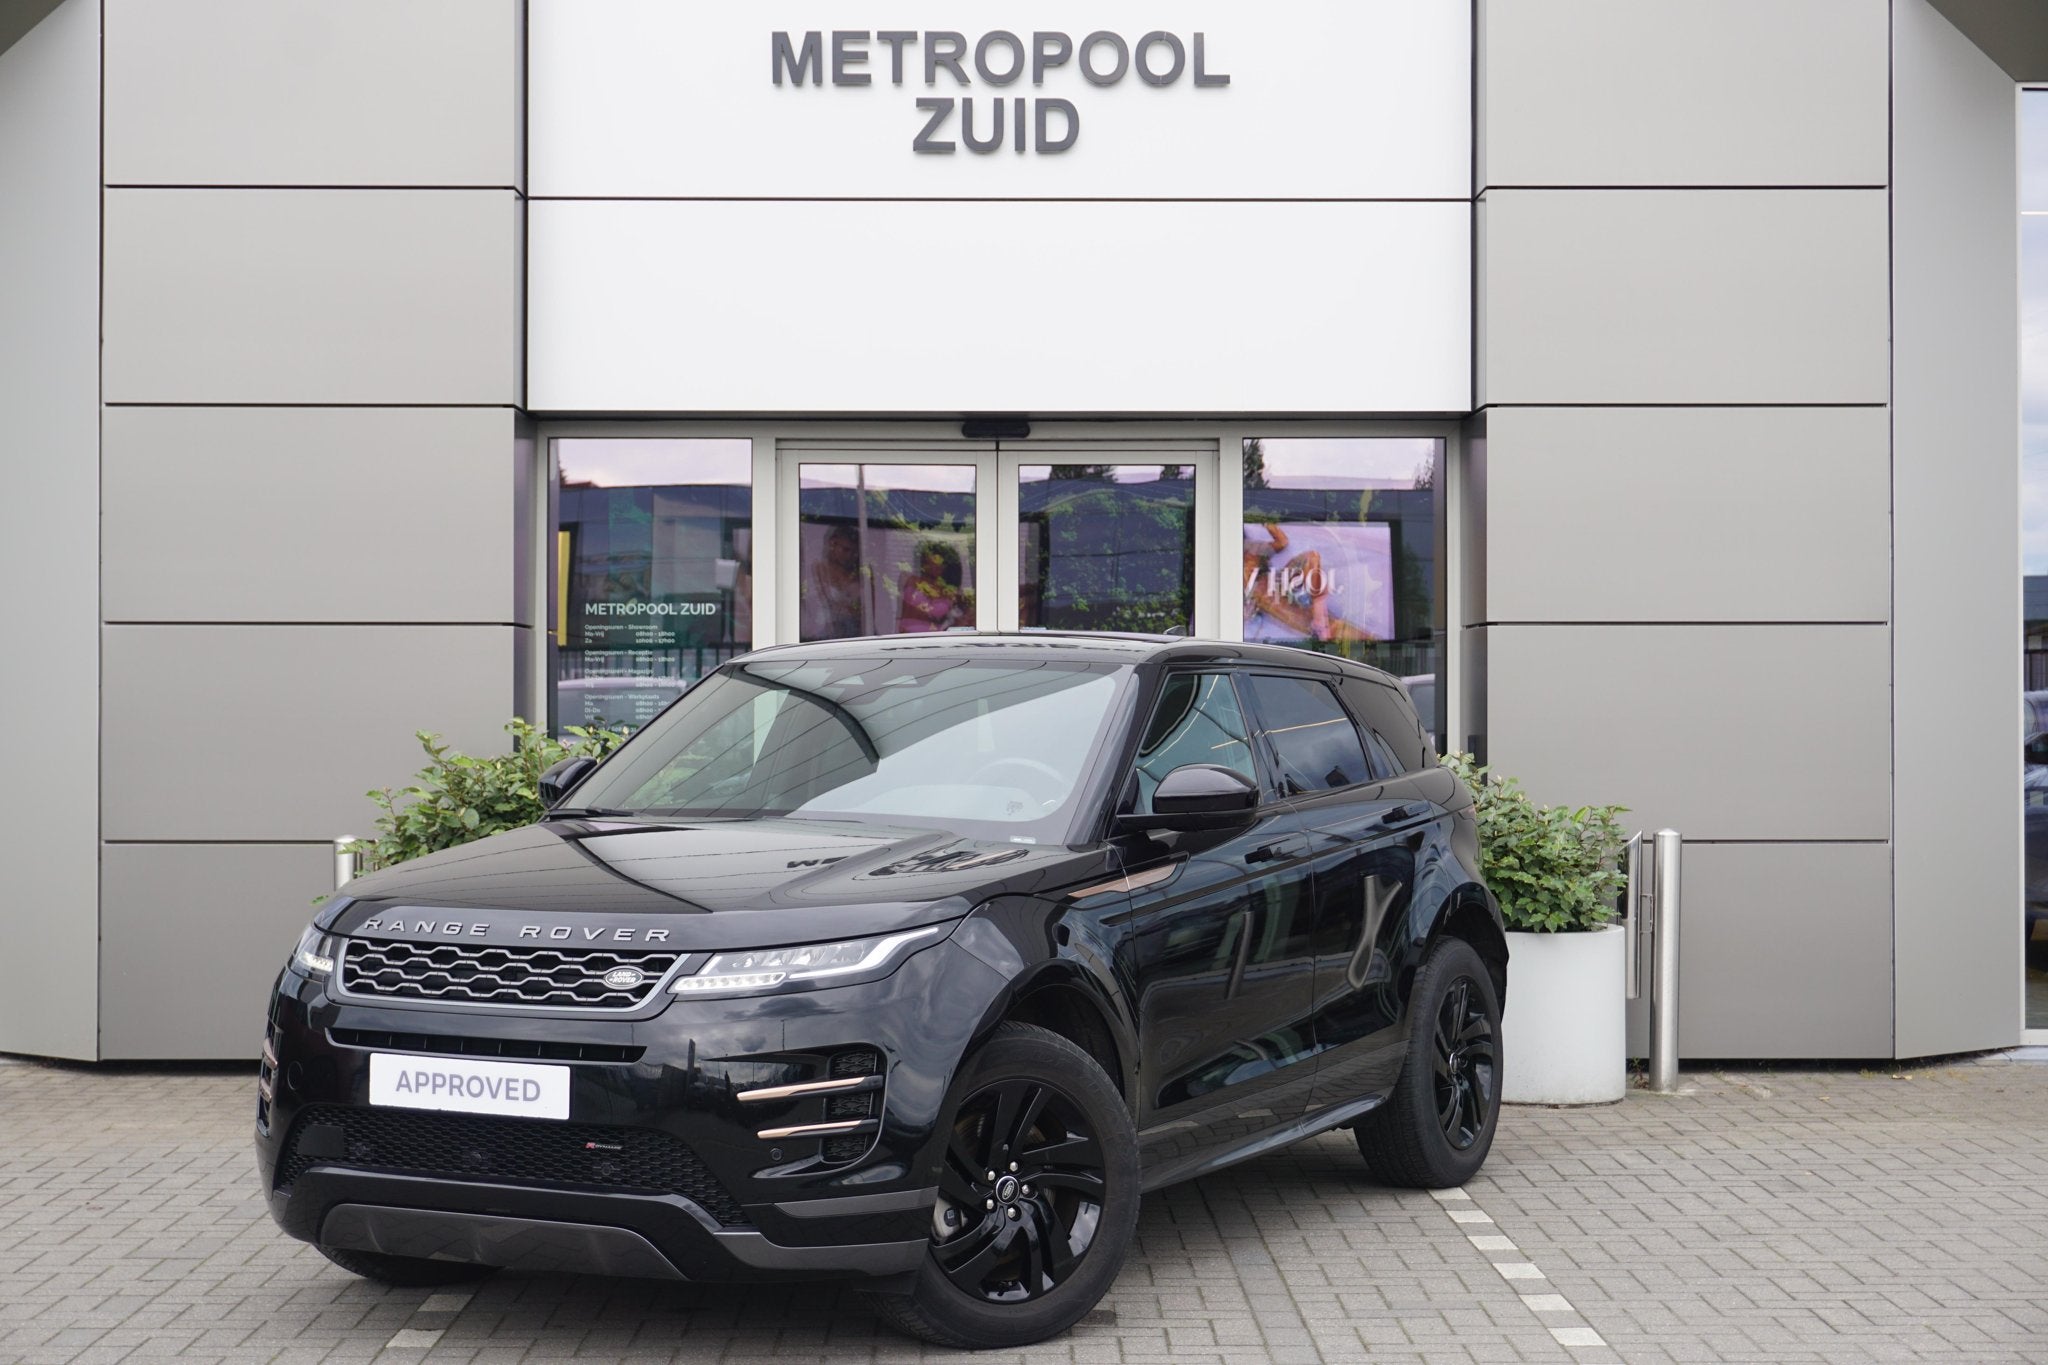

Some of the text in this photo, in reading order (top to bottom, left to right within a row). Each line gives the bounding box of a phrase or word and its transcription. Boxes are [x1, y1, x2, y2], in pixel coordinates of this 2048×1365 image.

[772, 30, 1230, 87] METROPOOL
[913, 97, 1080, 154] ZUID
[585, 603, 716, 615] METROPOOL ZUID
[364, 918, 671, 942] RANGE ROVER
[395, 1070, 541, 1102] APPROVED
